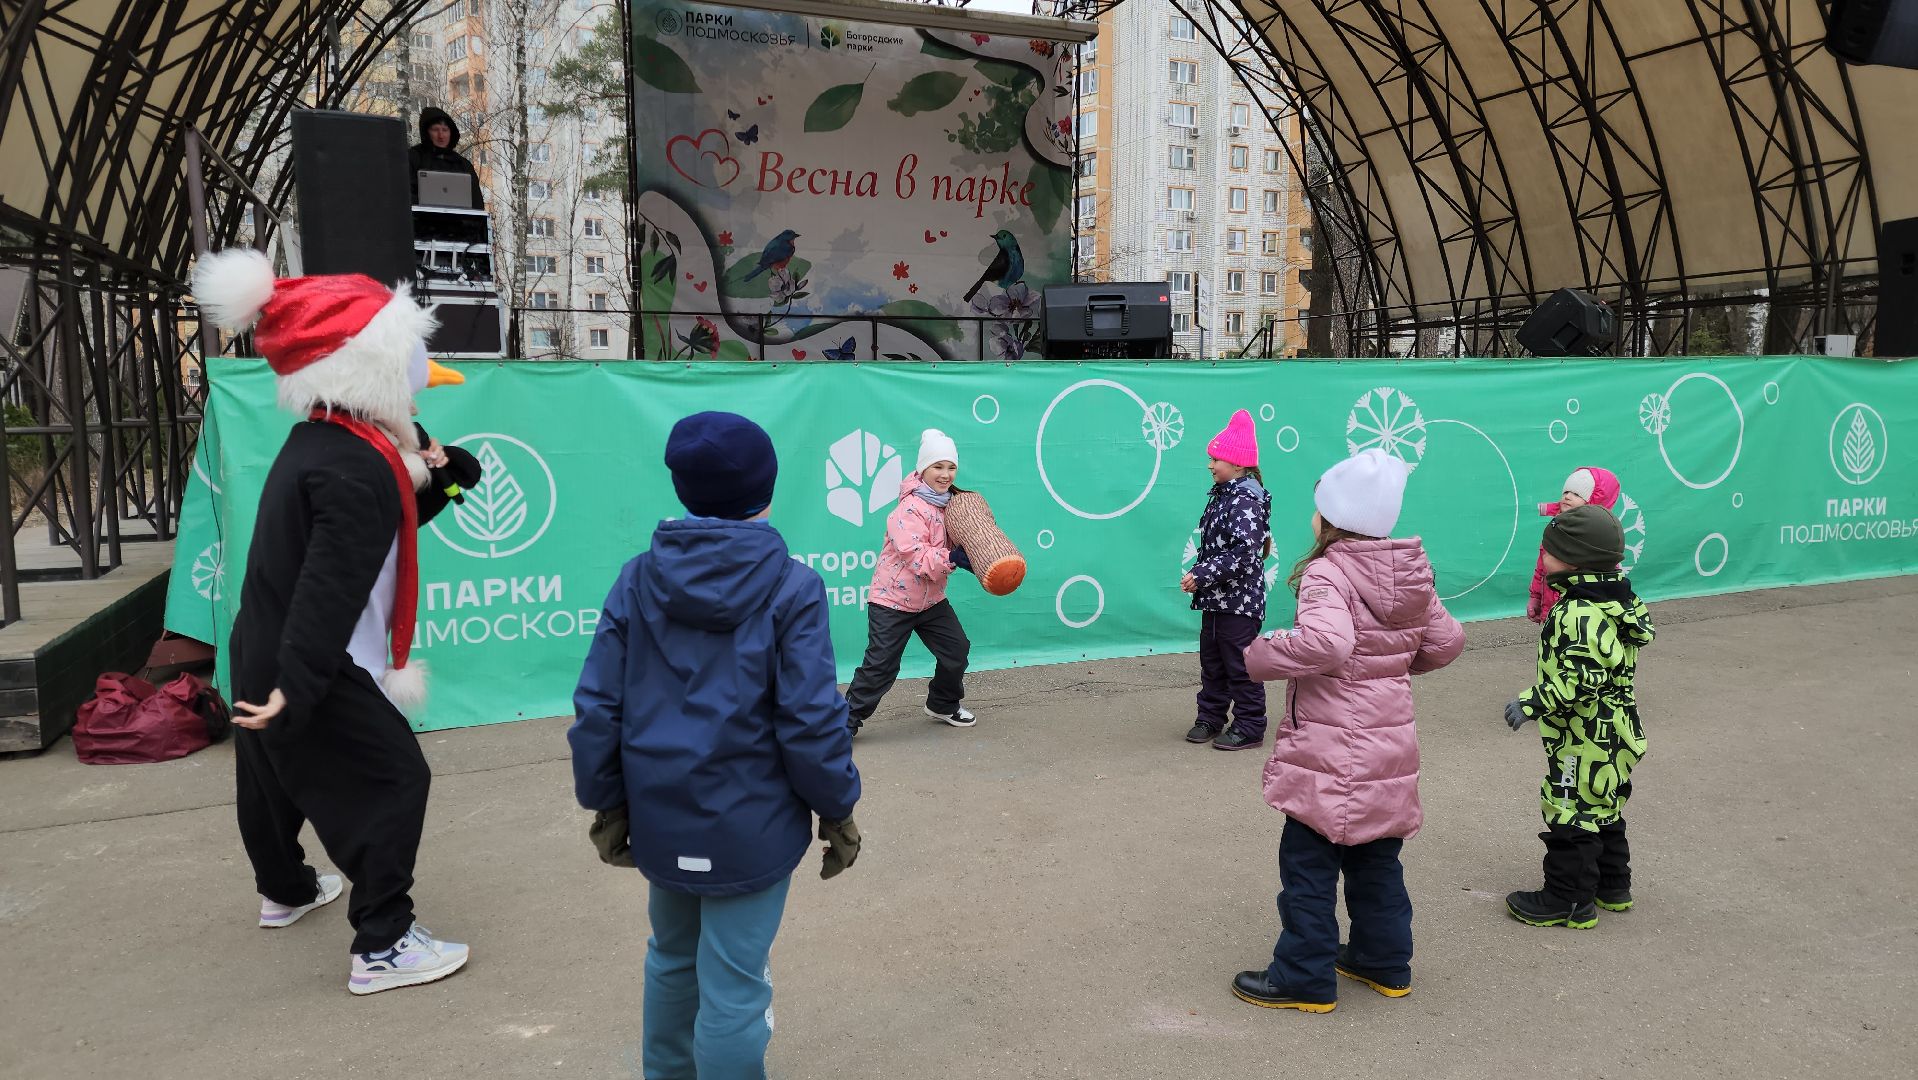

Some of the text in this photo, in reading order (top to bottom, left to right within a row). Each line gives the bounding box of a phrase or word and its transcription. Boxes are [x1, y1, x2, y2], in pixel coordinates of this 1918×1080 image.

[686, 11, 733, 26] ПАРКИ
[686, 25, 796, 46] ПОДМОСКОВЬЯ
[846, 43, 874, 53] парки
[756, 151, 1036, 219] Весна в парке
[1826, 496, 1887, 518] ПАРКИ
[426, 575, 562, 611] ПАРКИ
